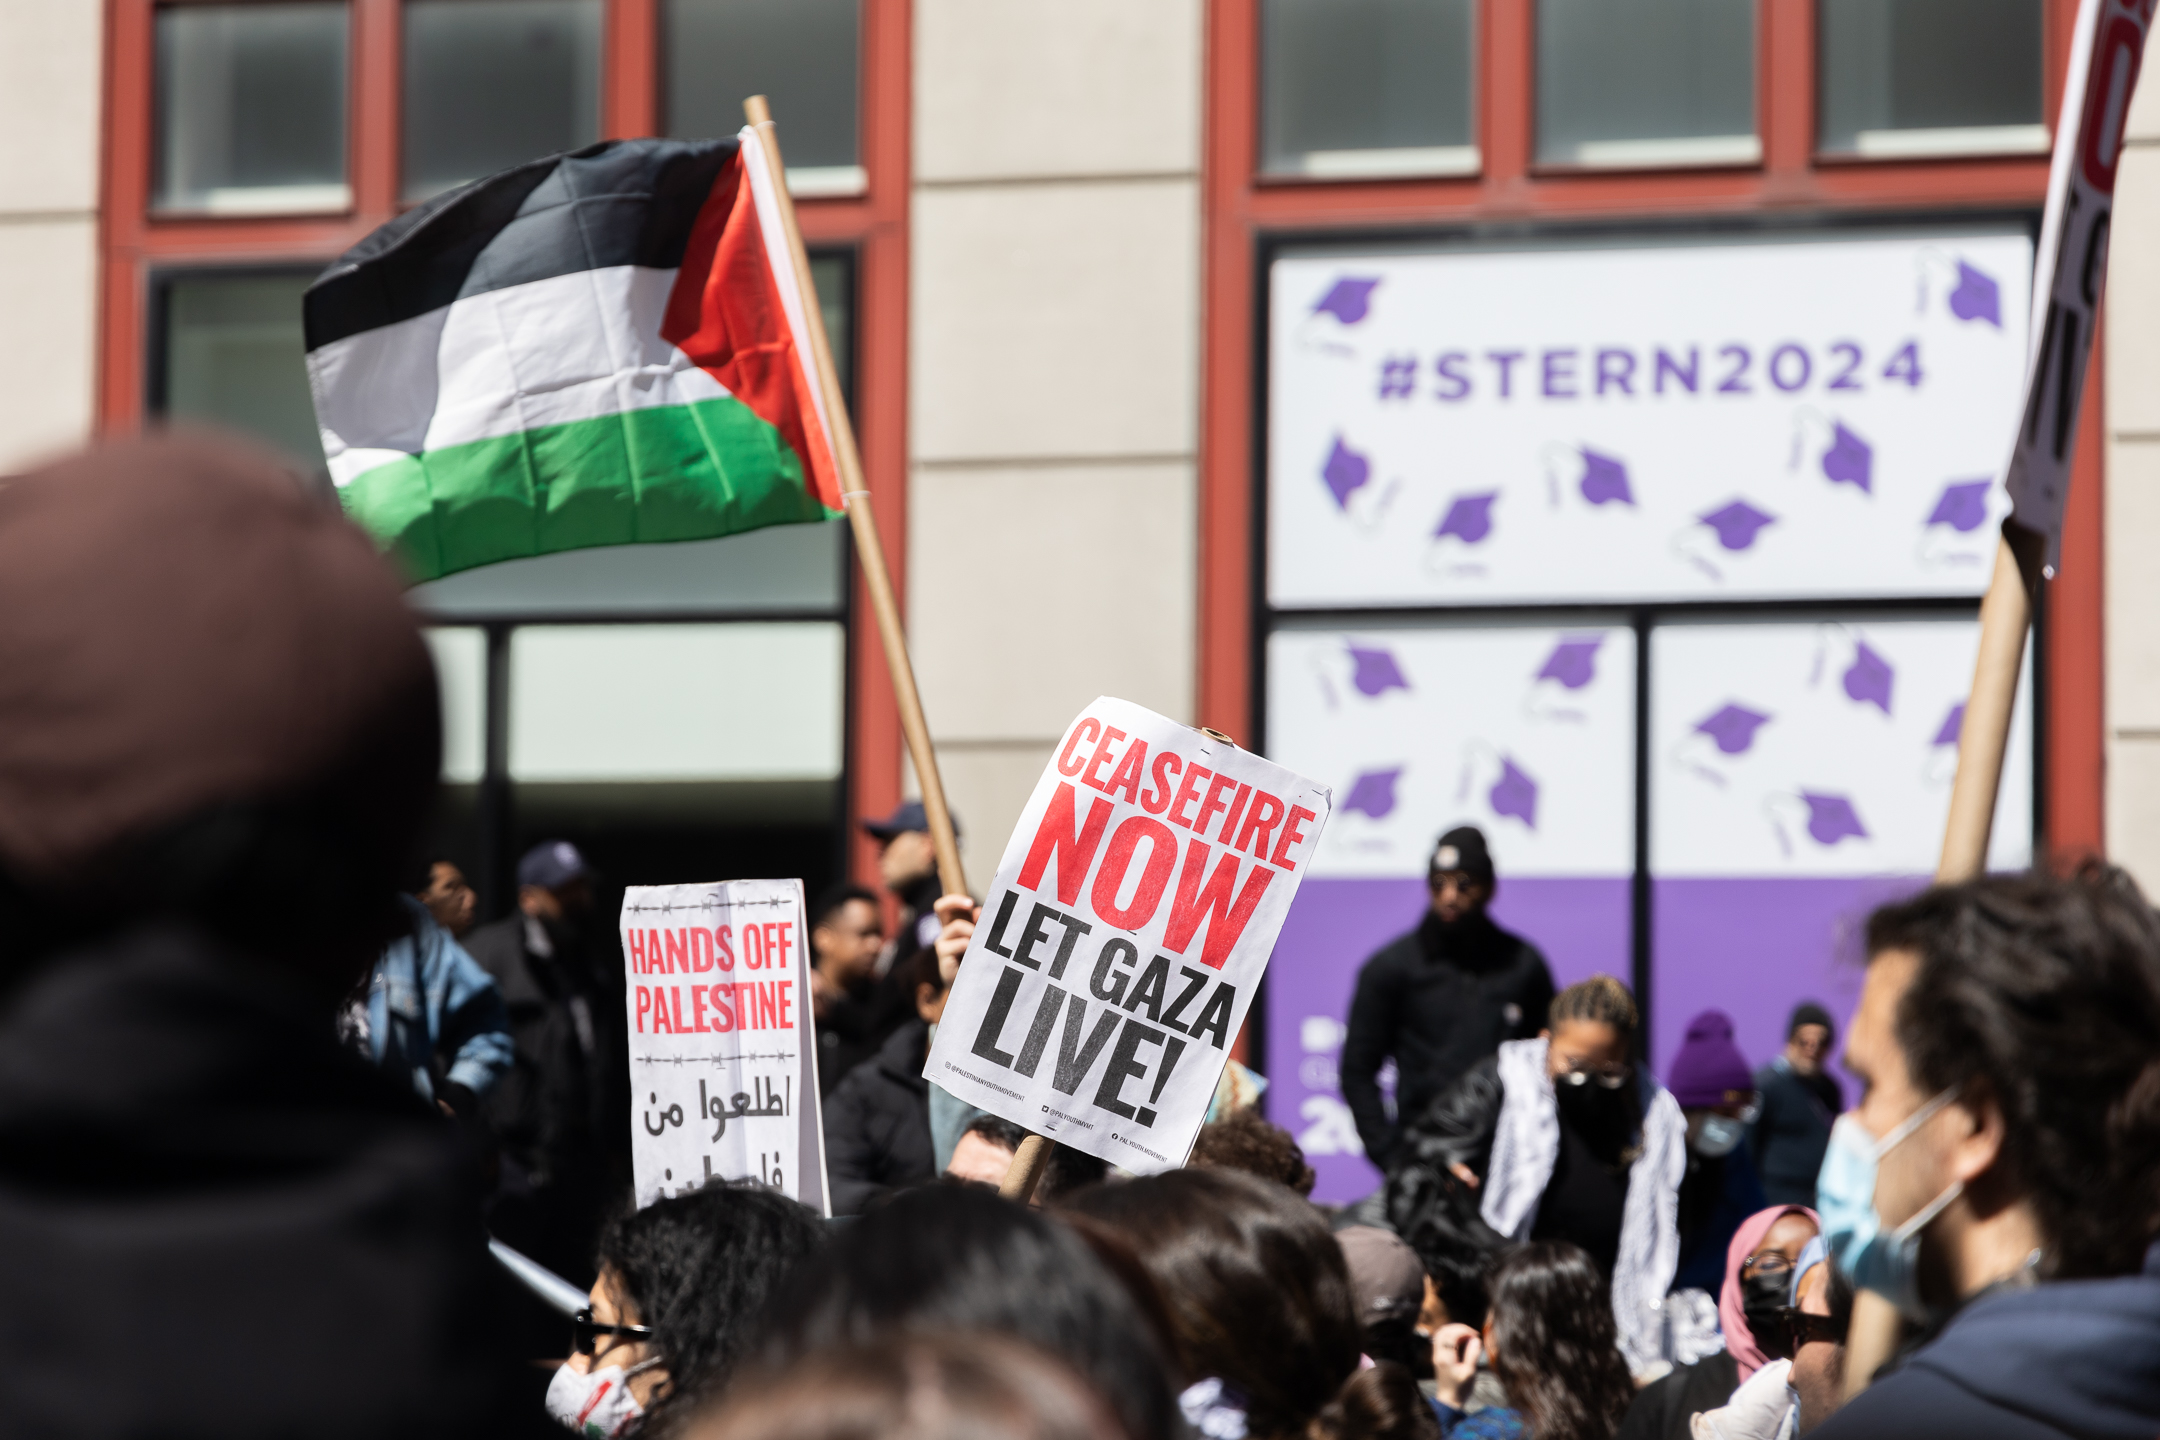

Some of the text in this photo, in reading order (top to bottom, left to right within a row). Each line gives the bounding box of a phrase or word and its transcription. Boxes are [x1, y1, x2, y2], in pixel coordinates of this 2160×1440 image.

[1377, 340, 1926, 402] #STERN2024
[1058, 717, 1317, 872] CEASEFIRE
[1016, 780, 1276, 971] NOW
[628, 921, 793, 975] HANDS OFF
[984, 889, 1237, 1051] LET GAZA
[636, 980, 794, 1034] PALESTINE
[970, 965, 1188, 1129] LIVE!
[644, 1075, 790, 1143] اطلعوا من
